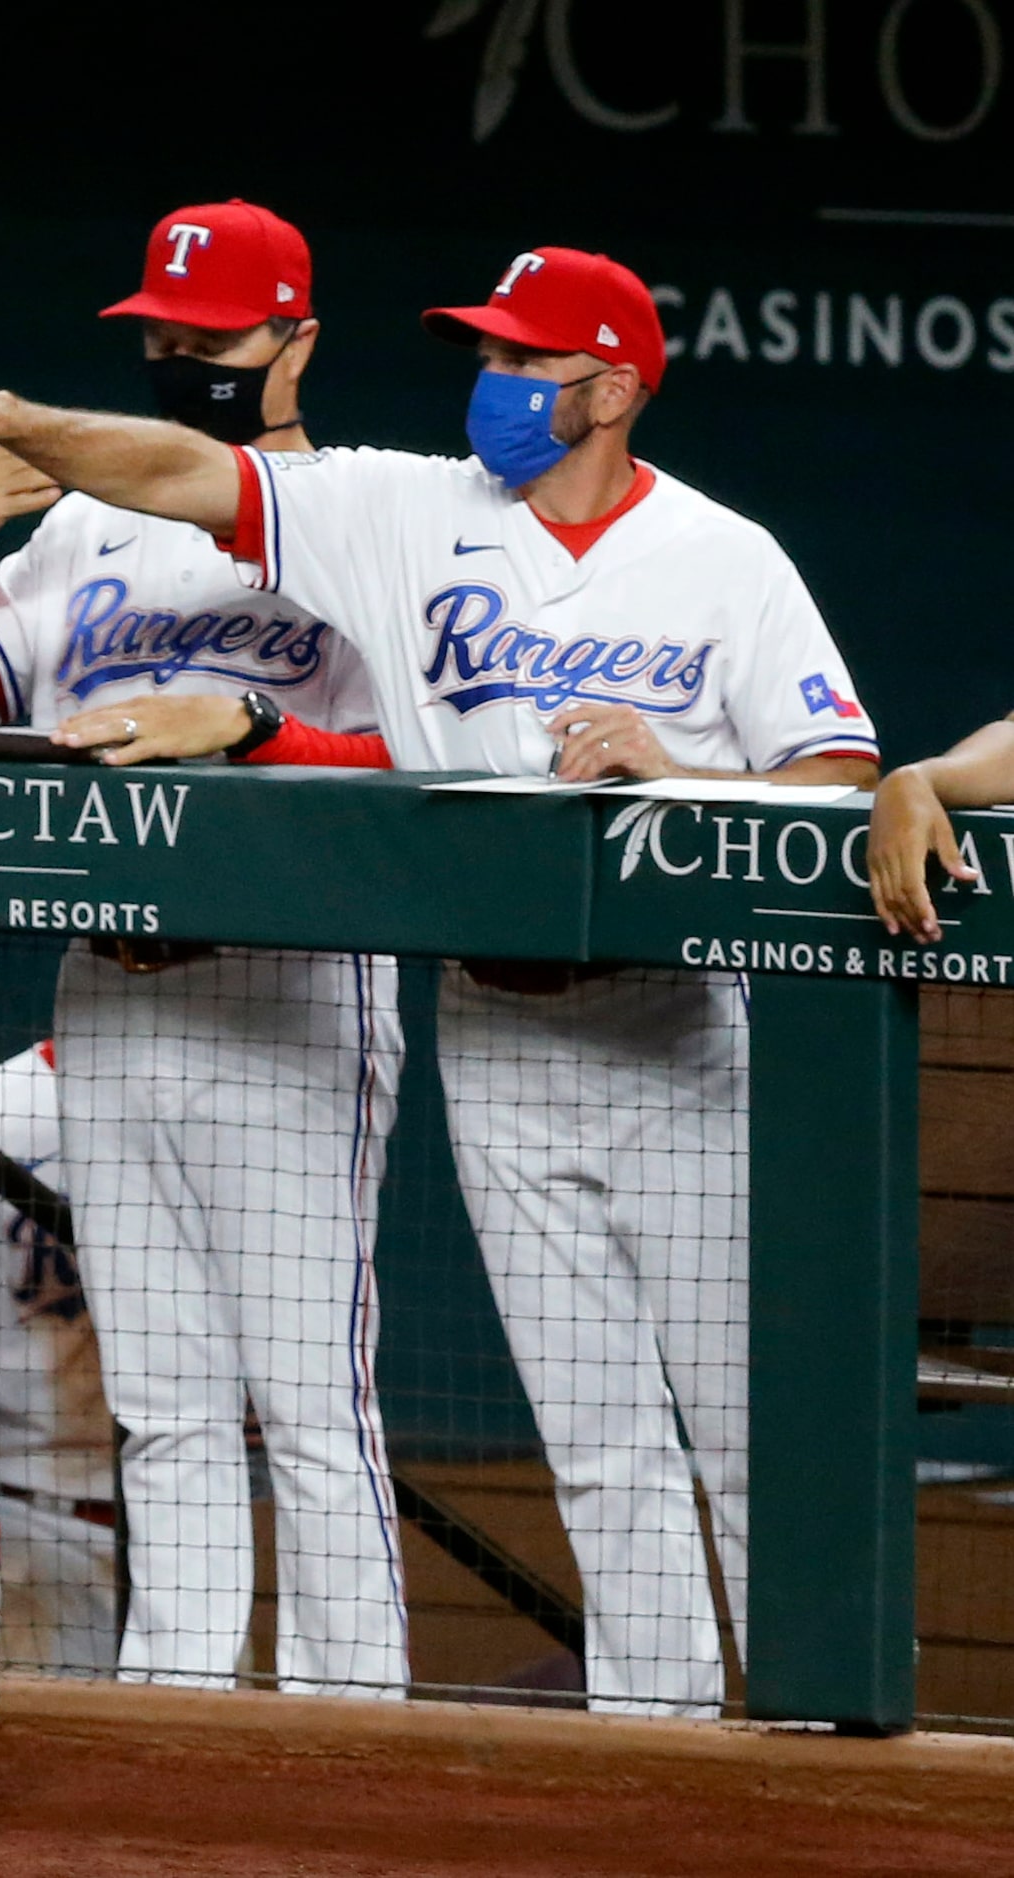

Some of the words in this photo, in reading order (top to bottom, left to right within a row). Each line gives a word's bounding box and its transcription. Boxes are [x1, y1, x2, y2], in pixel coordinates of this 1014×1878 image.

[165, 222, 211, 276] T
[494, 251, 545, 297] T
[528, 392, 545, 412] 8
[55, 574, 331, 696] Rangers
[423, 580, 720, 717] Rangers
[648, 801, 1014, 895] CHOCA
[7, 897, 160, 934] RESORTS
[681, 936, 835, 974] CASINOS
[845, 947, 865, 976] &
[877, 948, 1012, 985] RESORT
